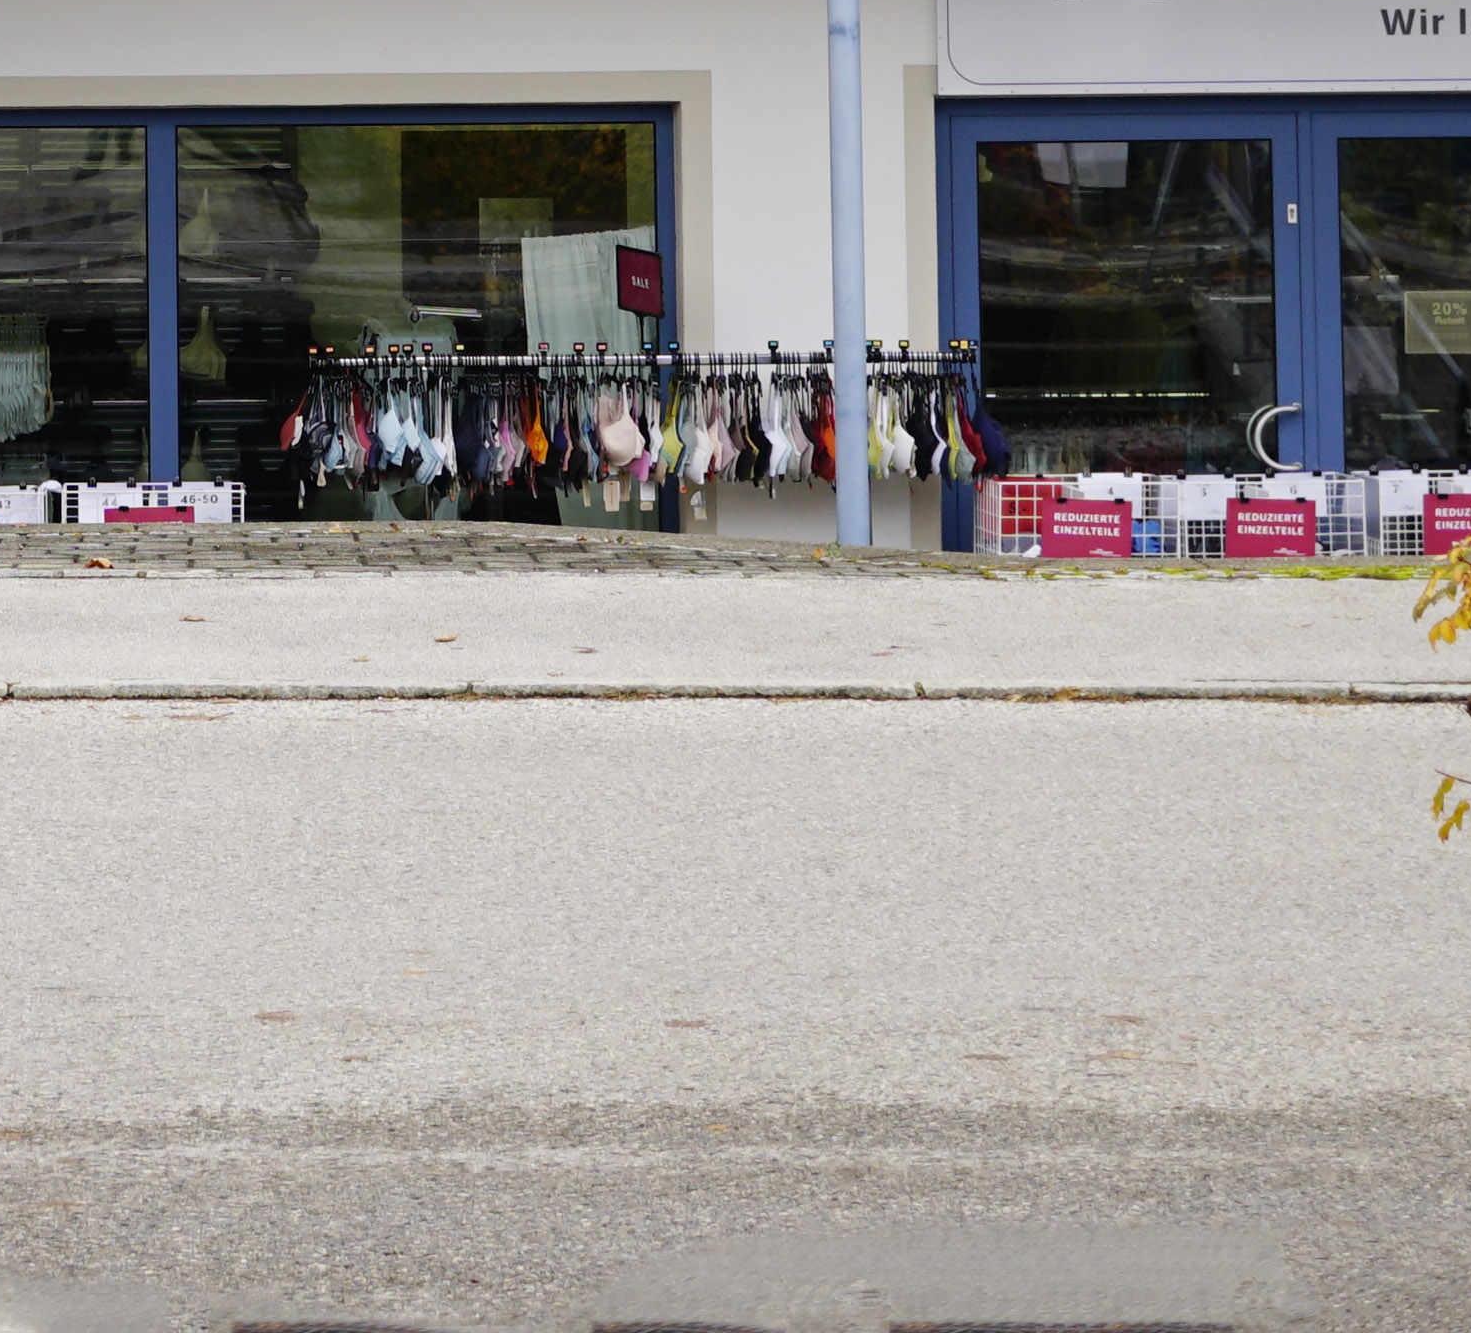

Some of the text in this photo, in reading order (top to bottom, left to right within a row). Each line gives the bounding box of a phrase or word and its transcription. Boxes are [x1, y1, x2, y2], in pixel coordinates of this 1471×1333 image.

[1379, 7, 1446, 36] Wir
[631, 275, 651, 290] SALE
[1432, 302, 1468, 316] 20%
[180, 494, 219, 504] 46-50
[1053, 512, 1121, 524] REDUZIERTE
[1237, 511, 1305, 523] REDUZIERTE
[1052, 525, 1121, 537] EINZELTEILE
[1236, 524, 1305, 536] EINZELTEILE
